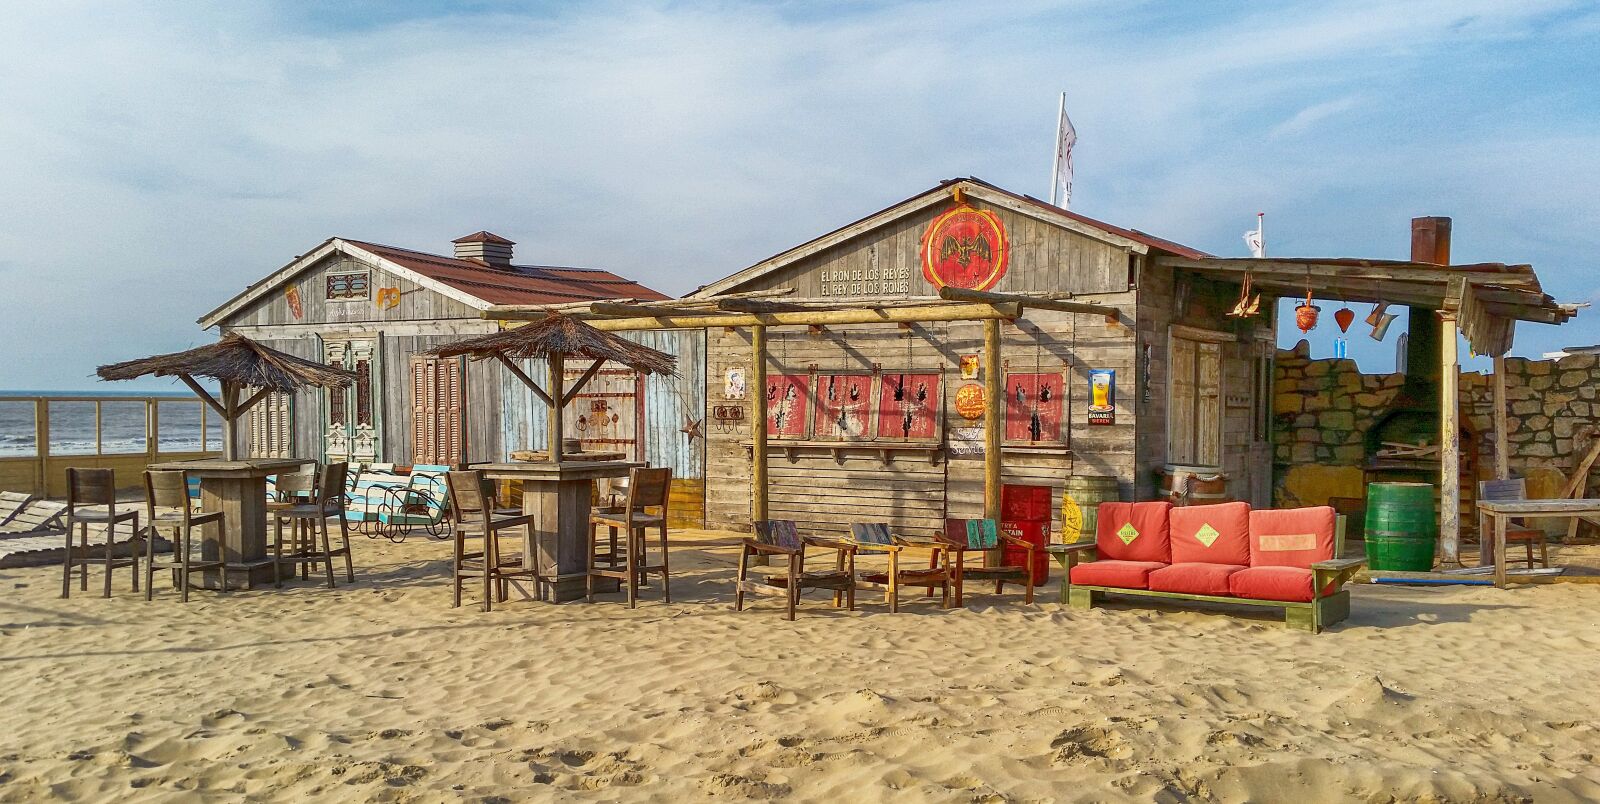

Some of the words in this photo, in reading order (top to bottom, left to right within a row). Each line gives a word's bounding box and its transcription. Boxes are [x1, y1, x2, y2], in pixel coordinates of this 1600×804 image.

[821, 271, 830, 282] EL
[833, 270, 850, 282] RON
[852, 269, 862, 281] DE
[865, 268, 880, 280] LOS
[883, 267, 910, 280] REYES
[822, 284, 830, 296] EL
[833, 283, 849, 295] REY
[852, 283, 861, 295] DE
[864, 282, 879, 294] LOS
[883, 281, 909, 294] RONES
[951, 441, 986, 455] Servic
